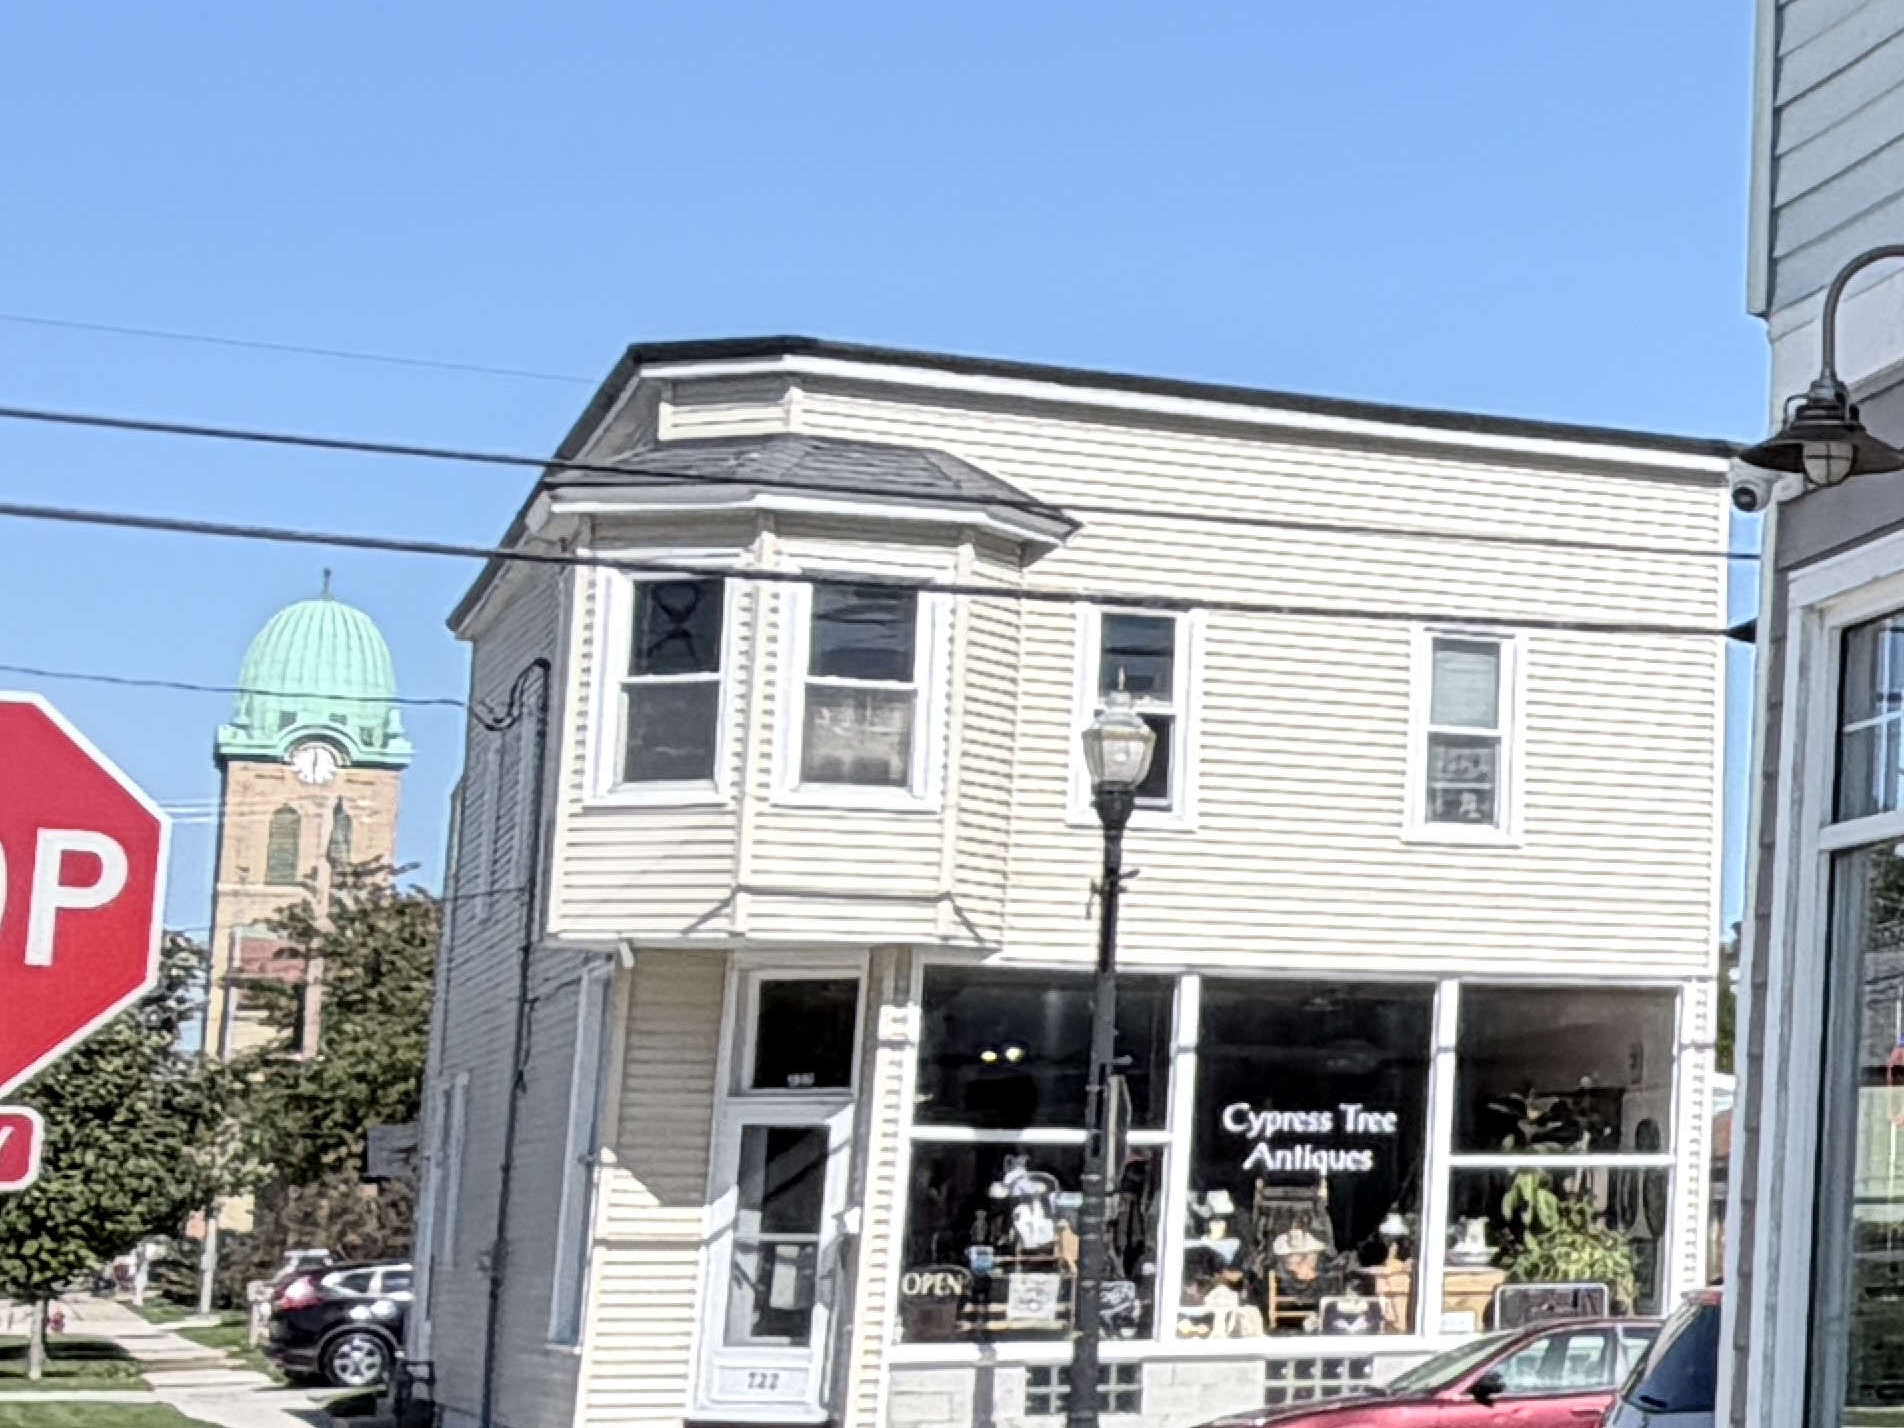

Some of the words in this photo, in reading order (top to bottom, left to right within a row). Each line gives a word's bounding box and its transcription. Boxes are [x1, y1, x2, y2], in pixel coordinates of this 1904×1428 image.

[1222, 1102, 1334, 1140] Cypress
[1338, 1102, 1398, 1134] Tree
[1241, 1141, 1374, 1177] Antiques
[902, 1272, 963, 1297] OPEN
